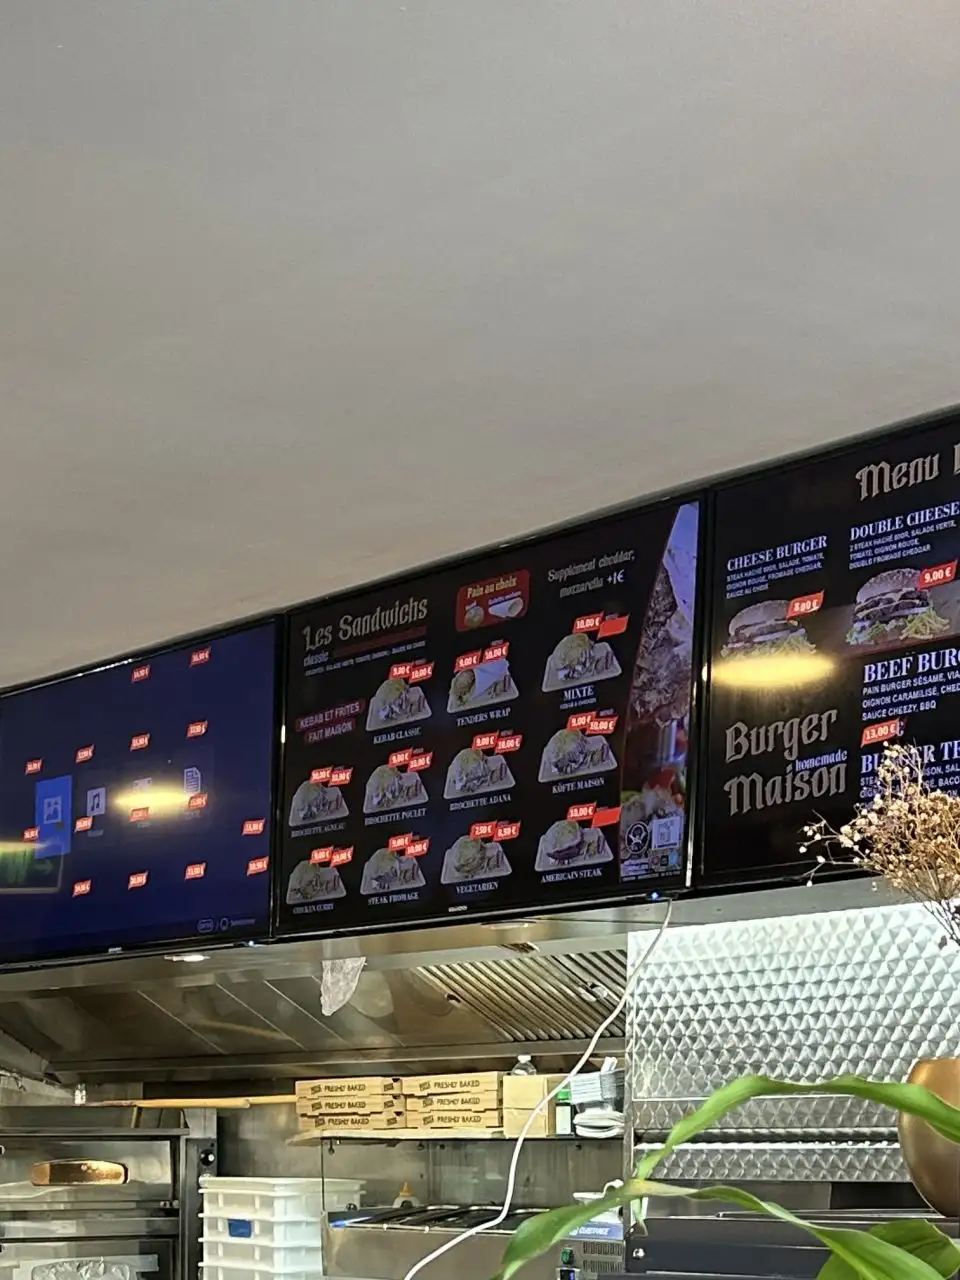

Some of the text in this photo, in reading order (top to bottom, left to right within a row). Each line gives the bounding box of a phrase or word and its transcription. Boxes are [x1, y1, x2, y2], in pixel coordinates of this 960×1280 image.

[855, 453, 940, 501] Menu
[850, 501, 960, 541] DOUBLE CHEESE
[727, 535, 828, 572] CHEESE BURGER
[303, 597, 428, 653] Les Sandwichs
[864, 648, 960, 684] BEEF BUR
[564, 685, 594, 701] MIXTE
[863, 686, 880, 695] PAIN
[880, 679, 912, 693] BURGER
[862, 696, 891, 708] OIGNON
[862, 709, 886, 721] SAUCE
[919, 700, 937, 711] BBQ
[300, 702, 360, 728] KEBAB ET FRITES
[456, 706, 512, 727] TENDERS WRAP
[725, 709, 838, 763] Burger
[796, 748, 848, 772] homemade
[724, 763, 847, 817] Maison
[580, 867, 602, 878] STEAK
[348, 1101, 366, 1109] BAKED
[461, 1097, 480, 1105] BAKED
[462, 1115, 481, 1123] BAKED
